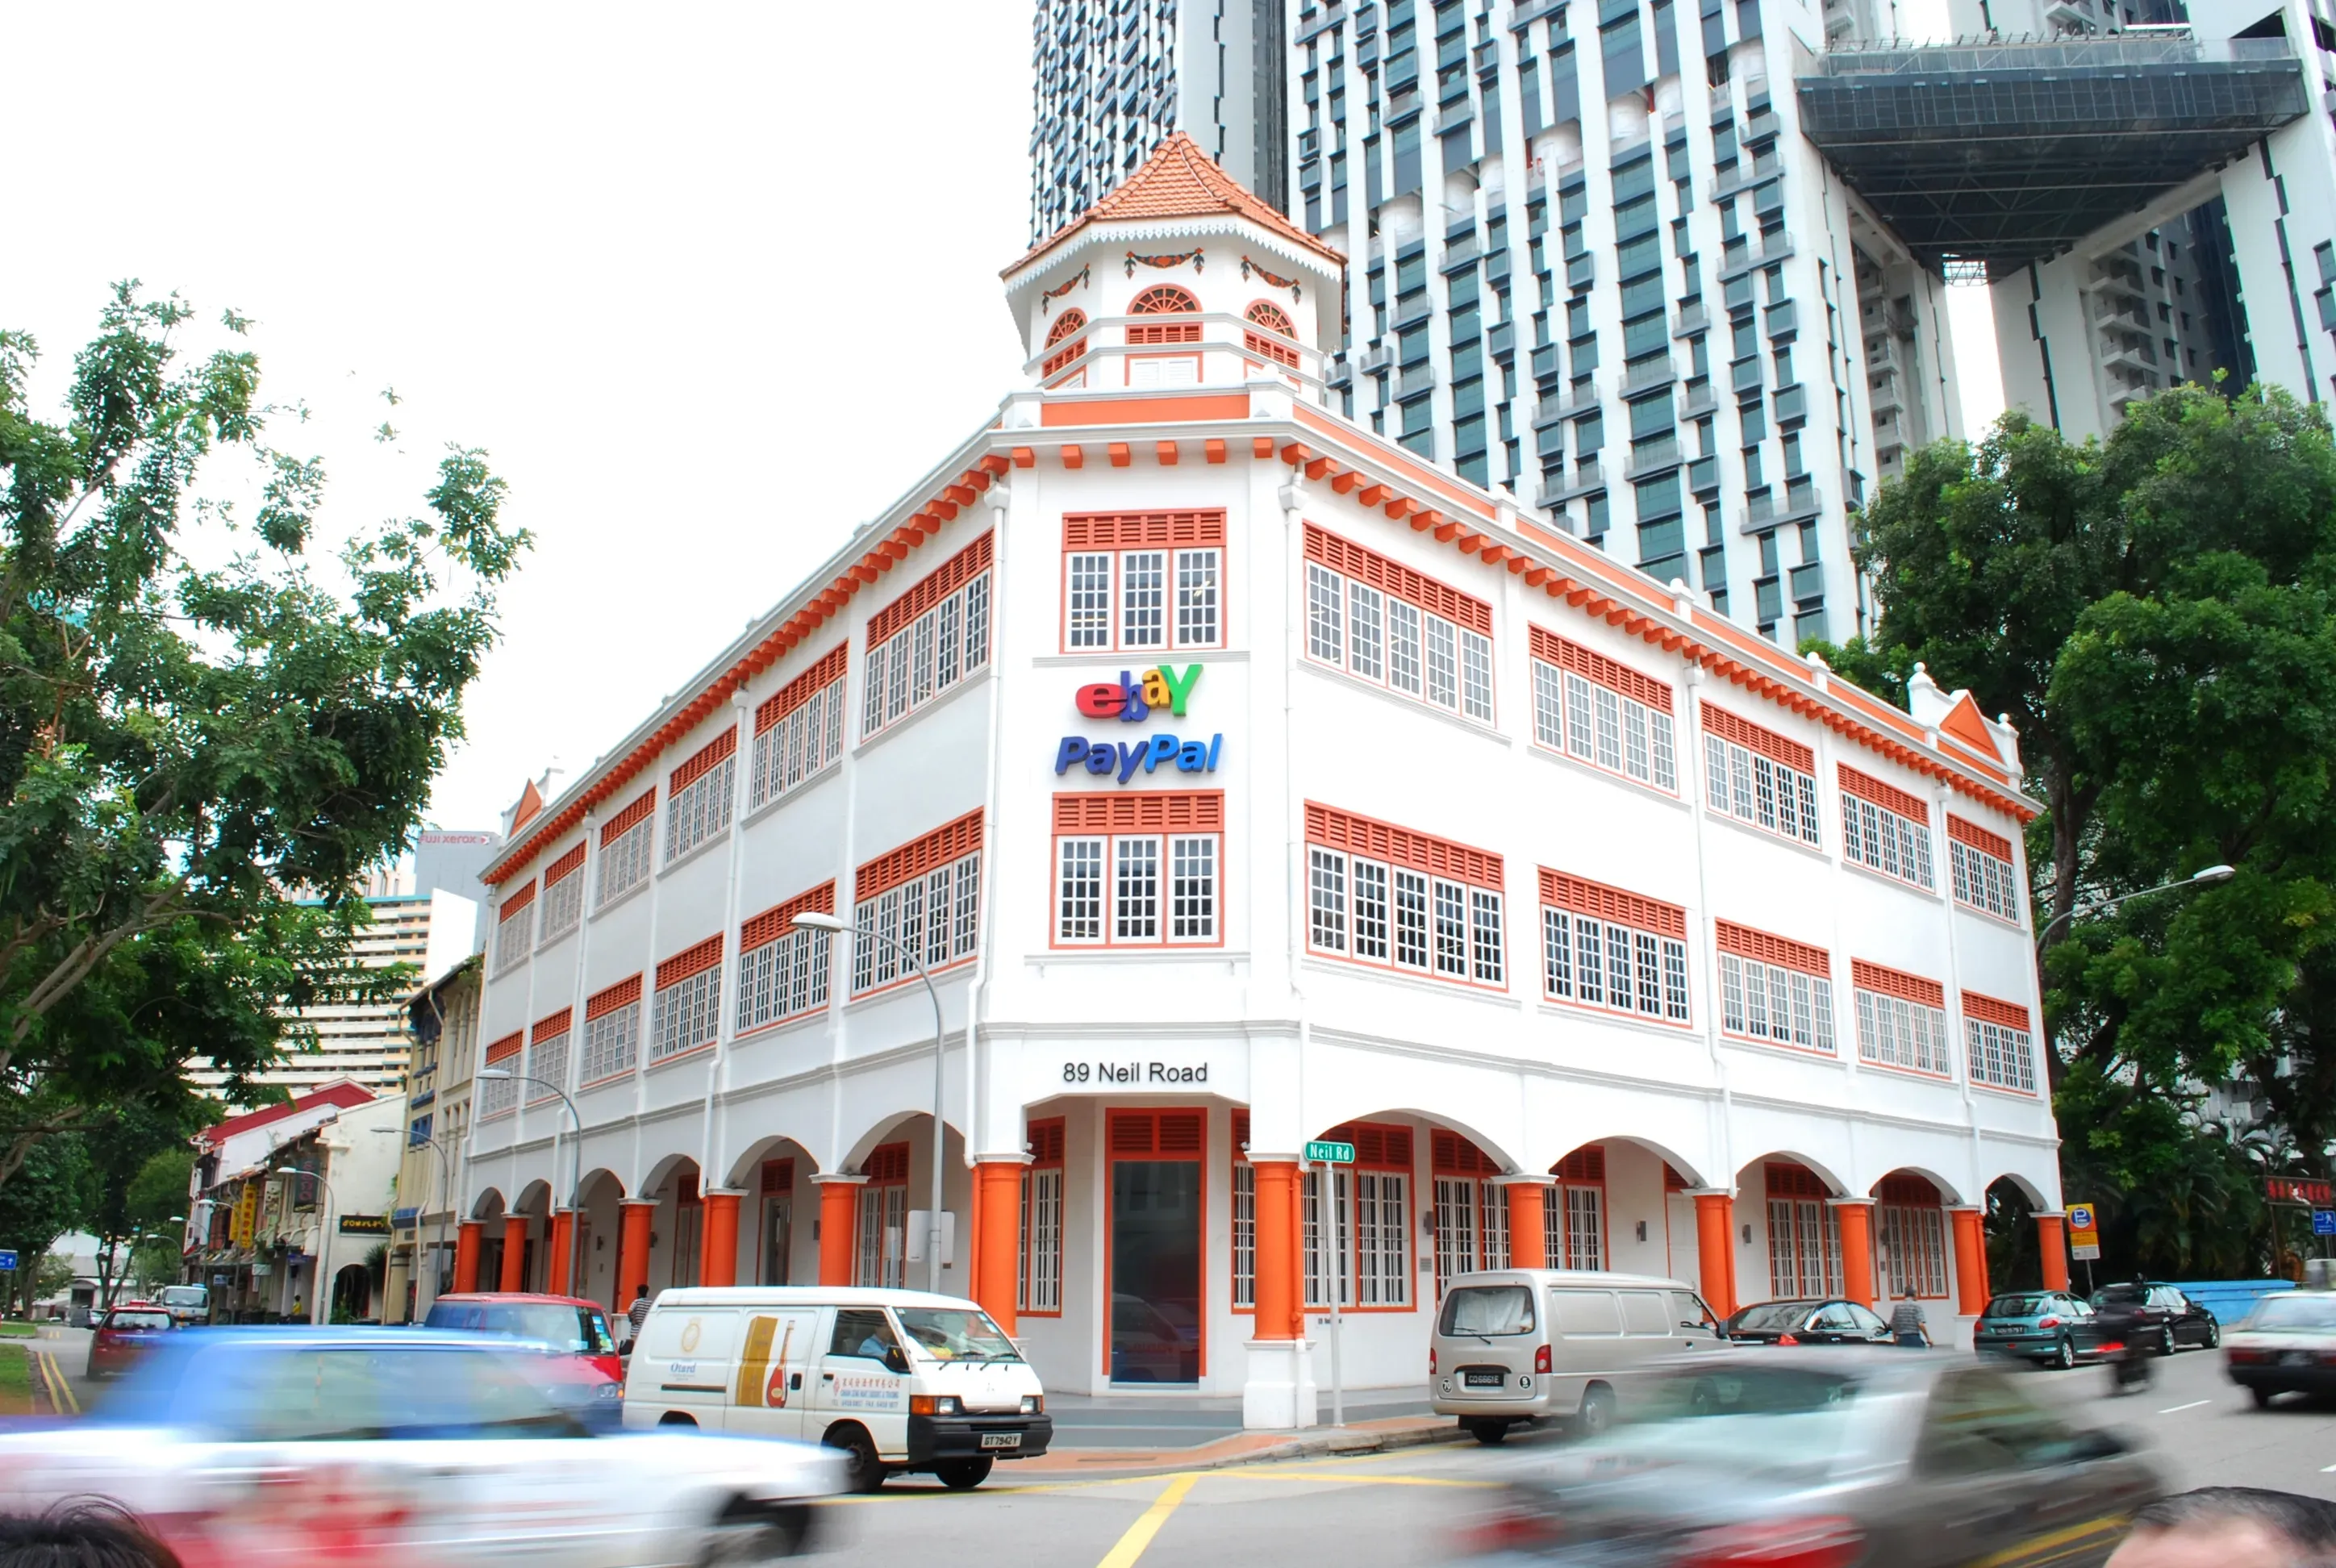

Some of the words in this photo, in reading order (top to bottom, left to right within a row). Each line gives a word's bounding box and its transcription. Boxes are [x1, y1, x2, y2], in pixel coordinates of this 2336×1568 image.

[1054, 733, 1223, 785] PayPal
[1063, 1062, 1090, 1082] 89
[1099, 1062, 1140, 1082] Neil
[1149, 1062, 1208, 1082] Road
[1310, 1144, 1333, 1159] Neil
[1336, 1145, 1349, 1161] Rd
[984, 1436, 1017, 1446] GT7942Y
